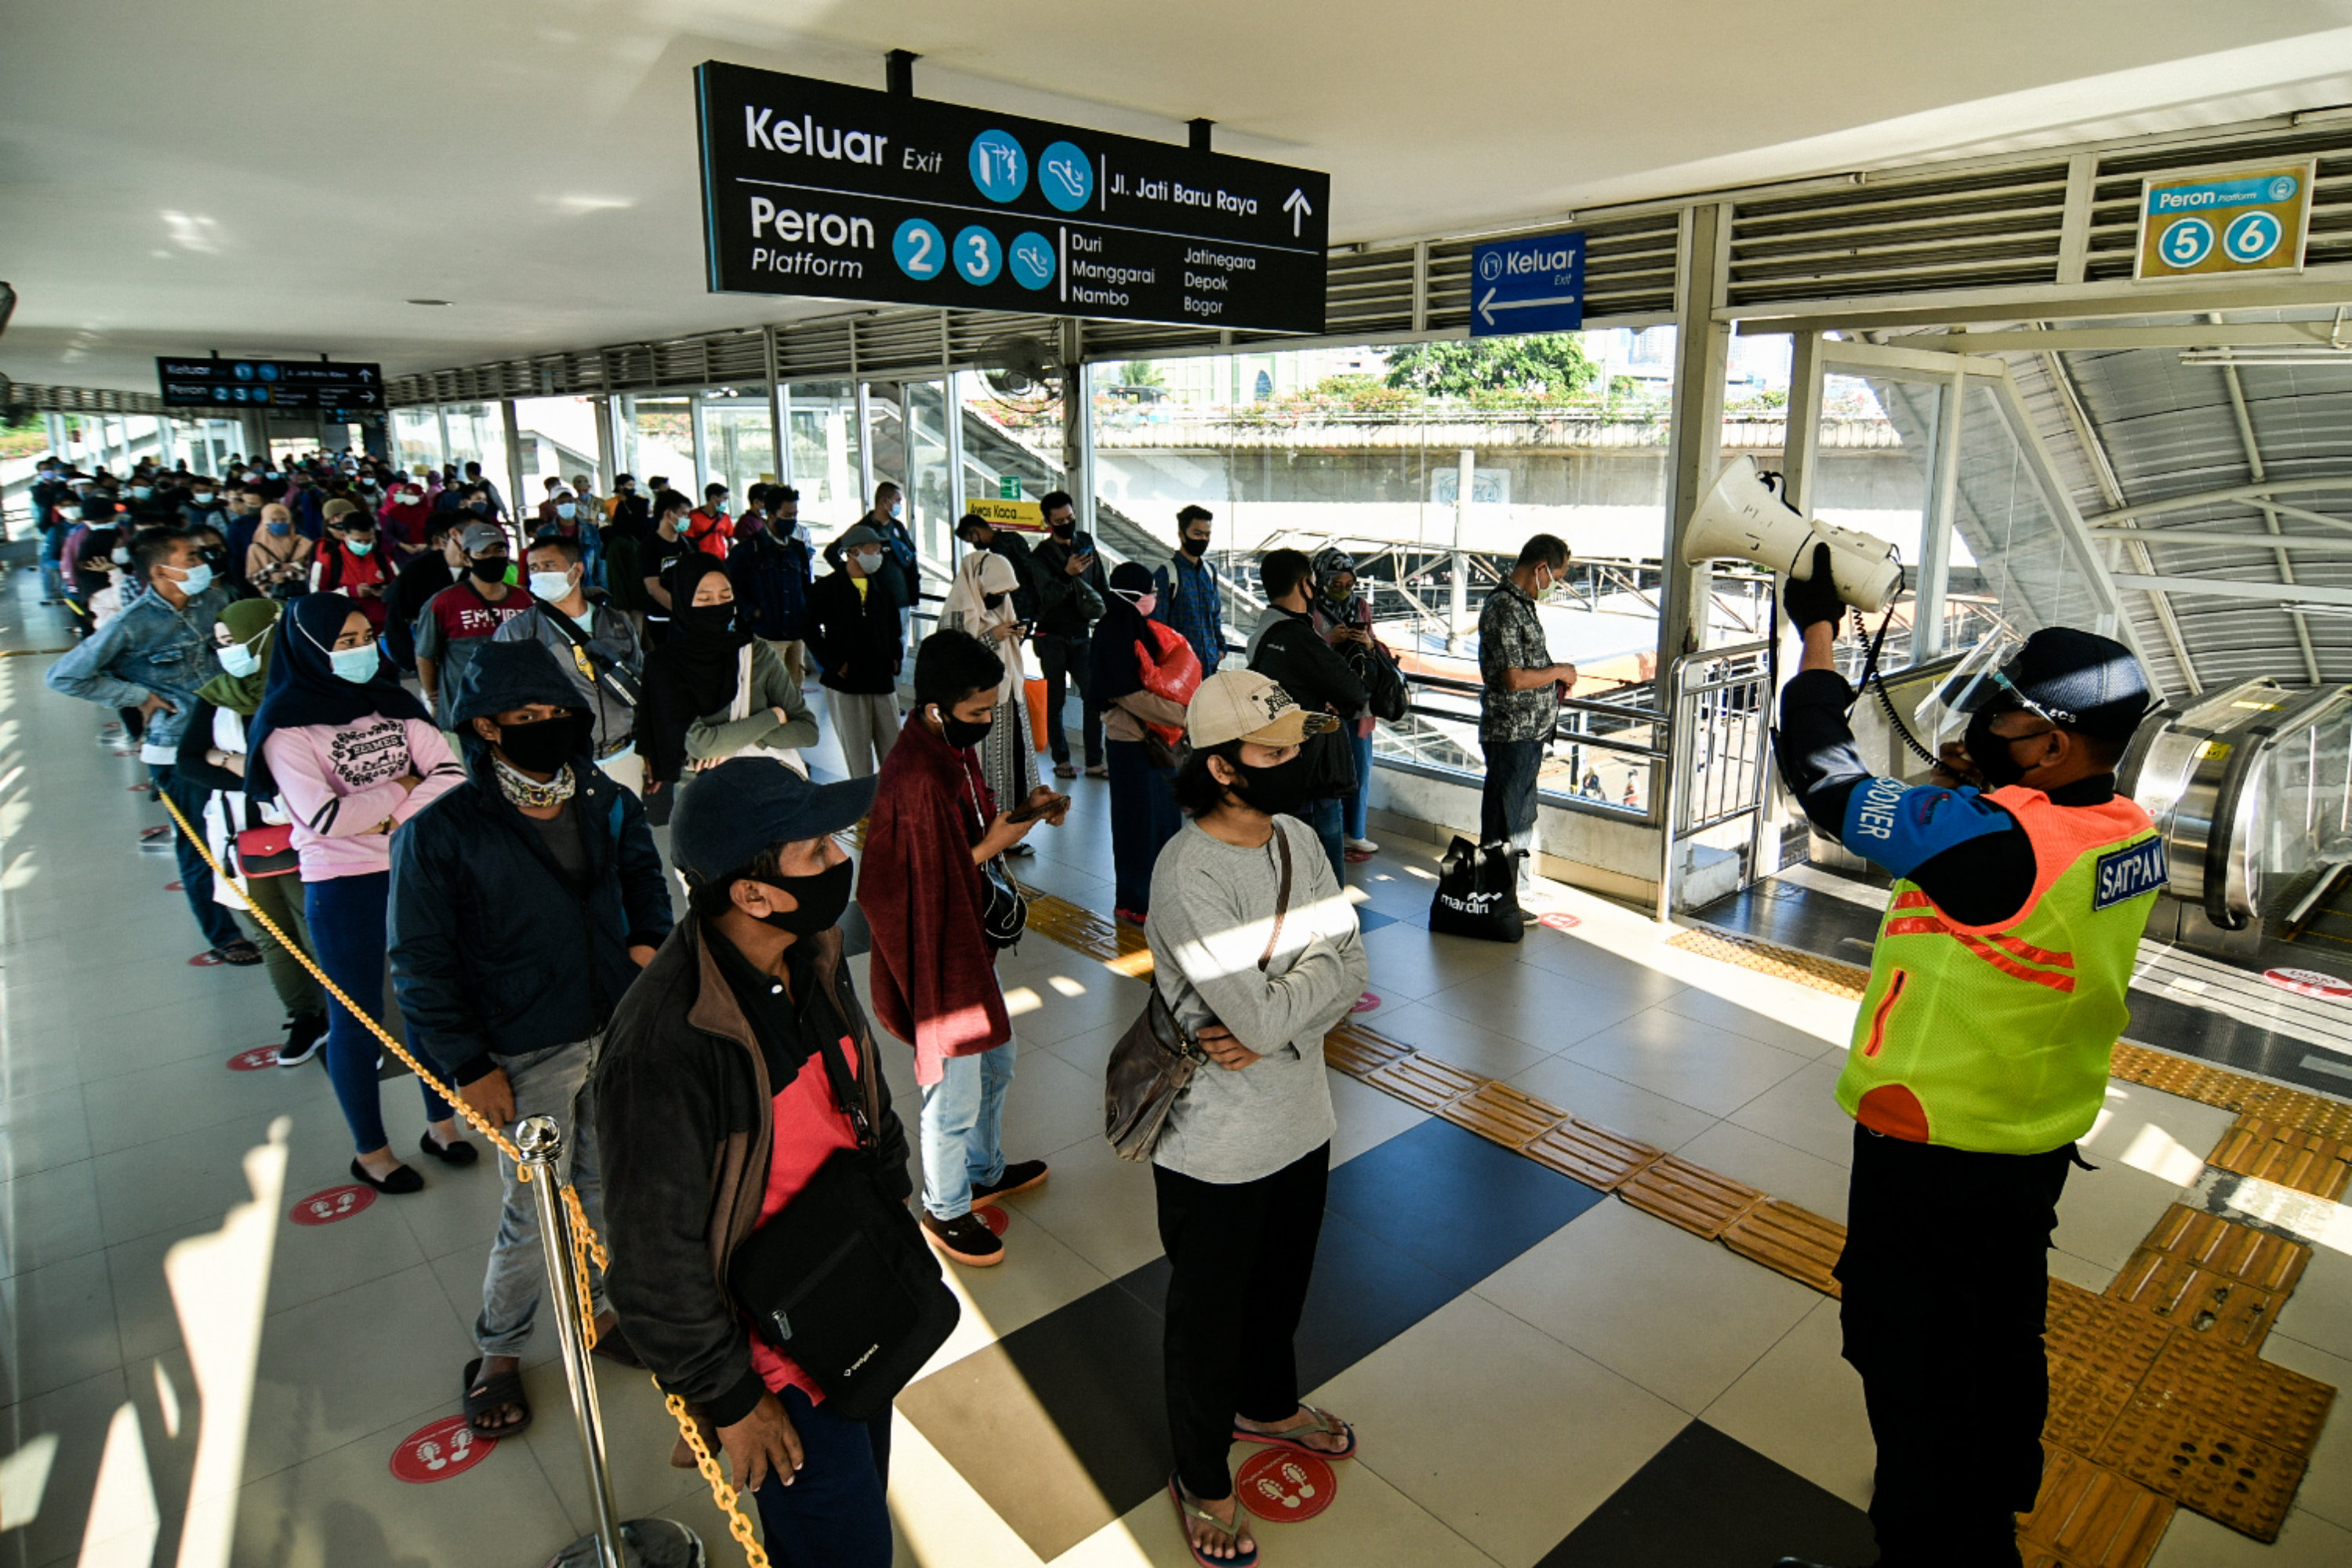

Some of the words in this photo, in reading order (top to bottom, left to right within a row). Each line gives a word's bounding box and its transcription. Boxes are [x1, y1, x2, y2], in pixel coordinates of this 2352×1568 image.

[745, 105, 888, 166] Keluar
[902, 147, 943, 174] Exit
[1110, 172, 1130, 196] Jl.
[1135, 177, 1168, 201] Jati
[1173, 182, 1212, 209] Baru
[1216, 190, 1258, 217] Raya
[2158, 191, 2216, 209] Peron
[2217, 192, 2257, 203] Platform
[750, 196, 874, 249] Peron
[907, 228, 933, 273] 2
[966, 234, 990, 278] 3
[1072, 233, 1103, 253] Duri
[2172, 227, 2198, 260] 5
[2238, 219, 2265, 252] 6
[751, 247, 863, 279] Platform
[1183, 247, 1256, 271] Jatinegara
[1506, 249, 1576, 274] Keluar
[1072, 259, 1156, 285] Manggarai
[1184, 271, 1229, 292] Depok
[1554, 273, 1572, 285] Exit
[1073, 285, 1130, 307] Nambo
[1184, 295, 1224, 317] Bogor
[216, 387, 227, 400] 2
[235, 388, 245, 401] 3
[971, 503, 991, 517] Awas
[993, 504, 1017, 520] Kaca
[460, 608, 524, 626] EMPIR
[1440, 893, 1490, 915] mandiri
